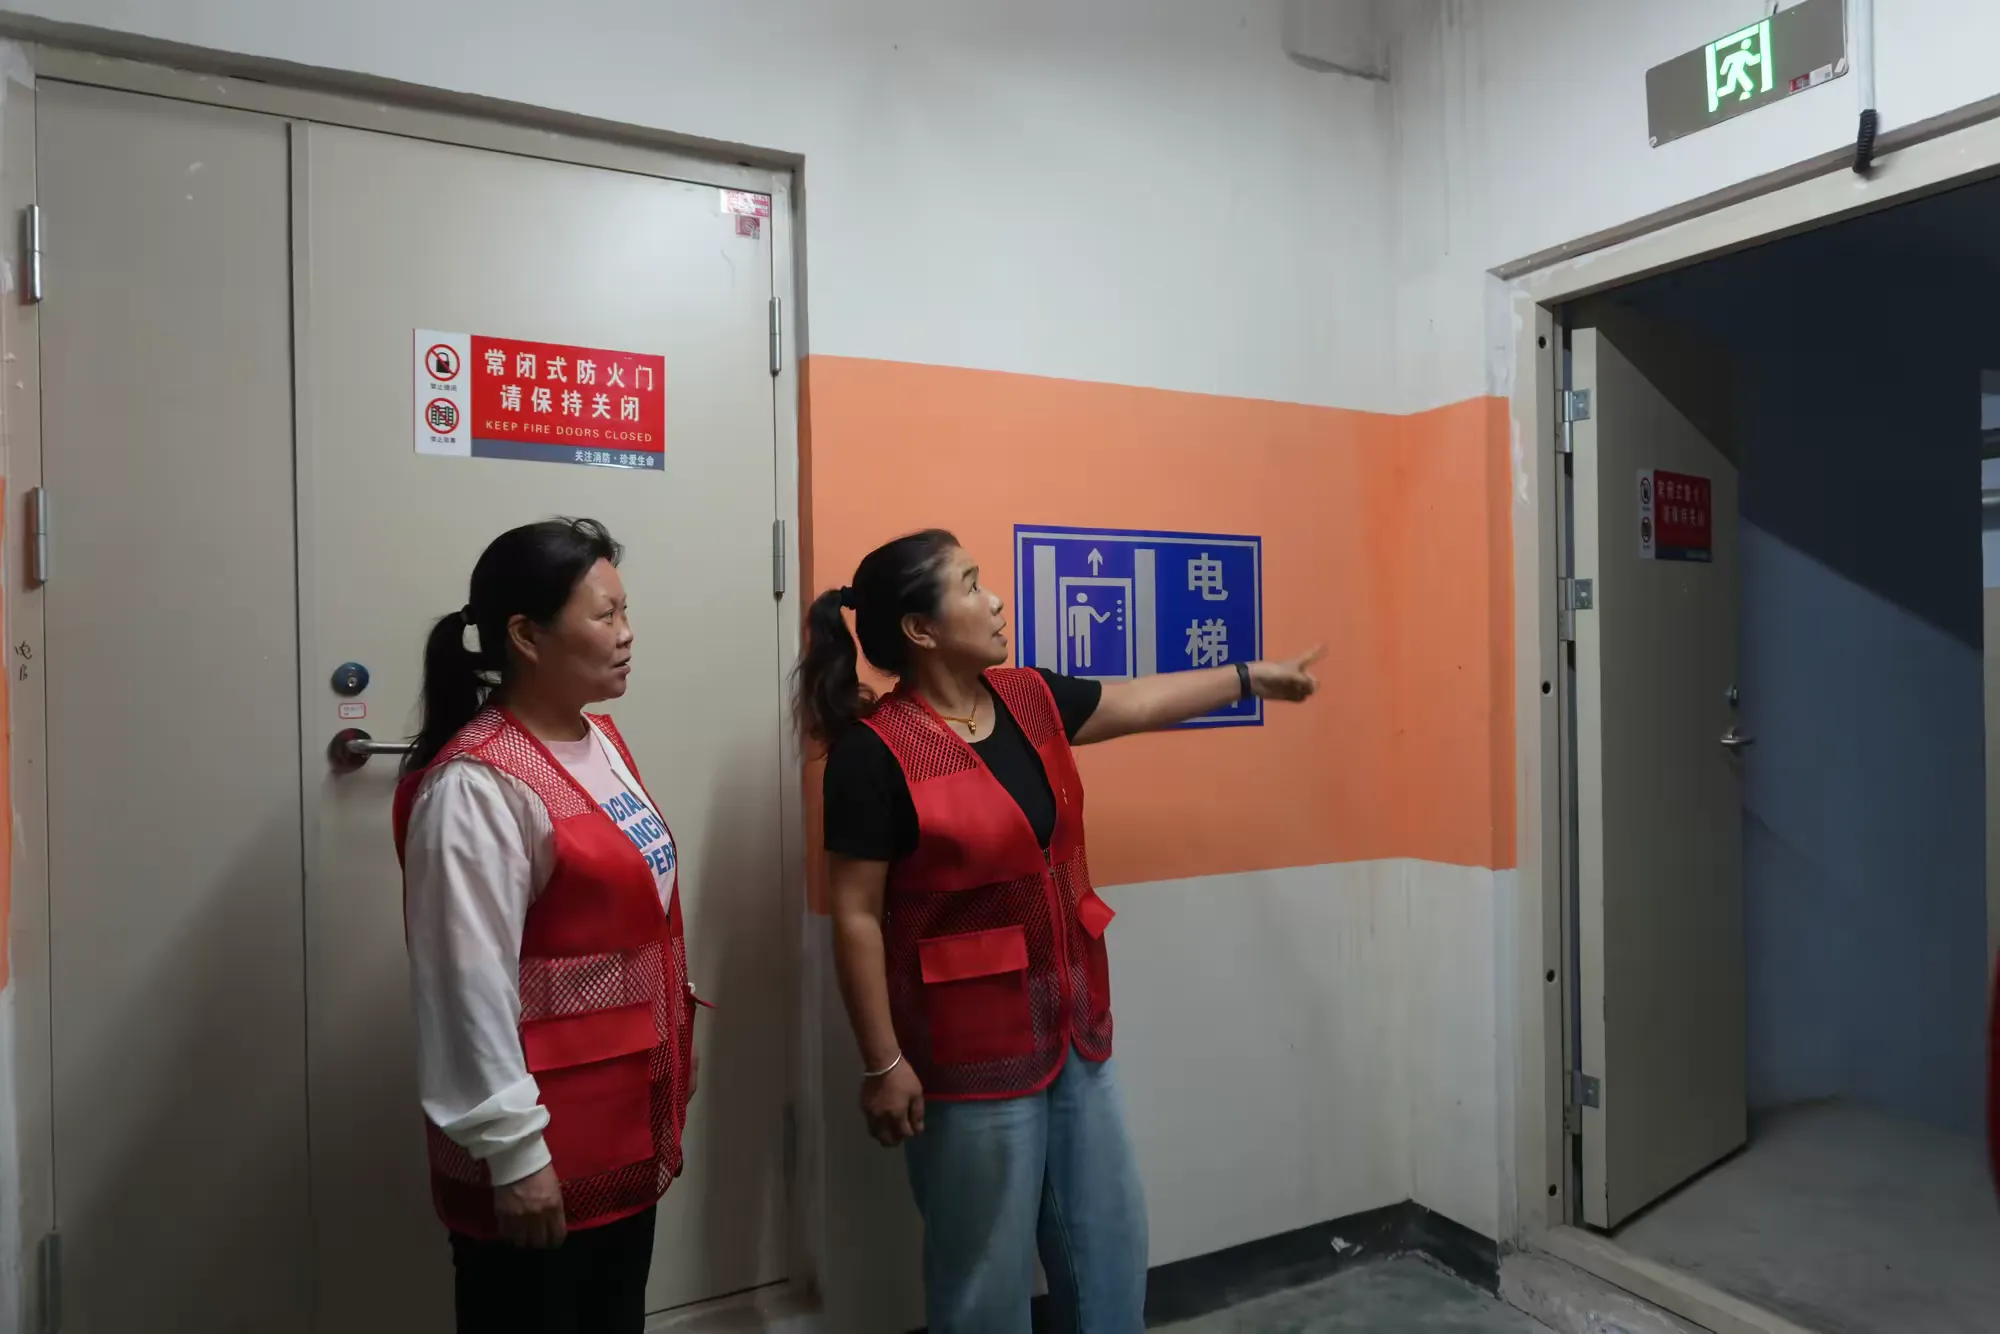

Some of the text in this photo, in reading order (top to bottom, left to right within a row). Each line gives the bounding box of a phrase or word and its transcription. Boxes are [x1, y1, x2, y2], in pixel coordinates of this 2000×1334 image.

[484, 348, 653, 391] 常闭式防火门
[500, 384, 640, 422] 请保持关闭
[486, 420, 652, 442] KEEP FIRE DOORS CLOSED
